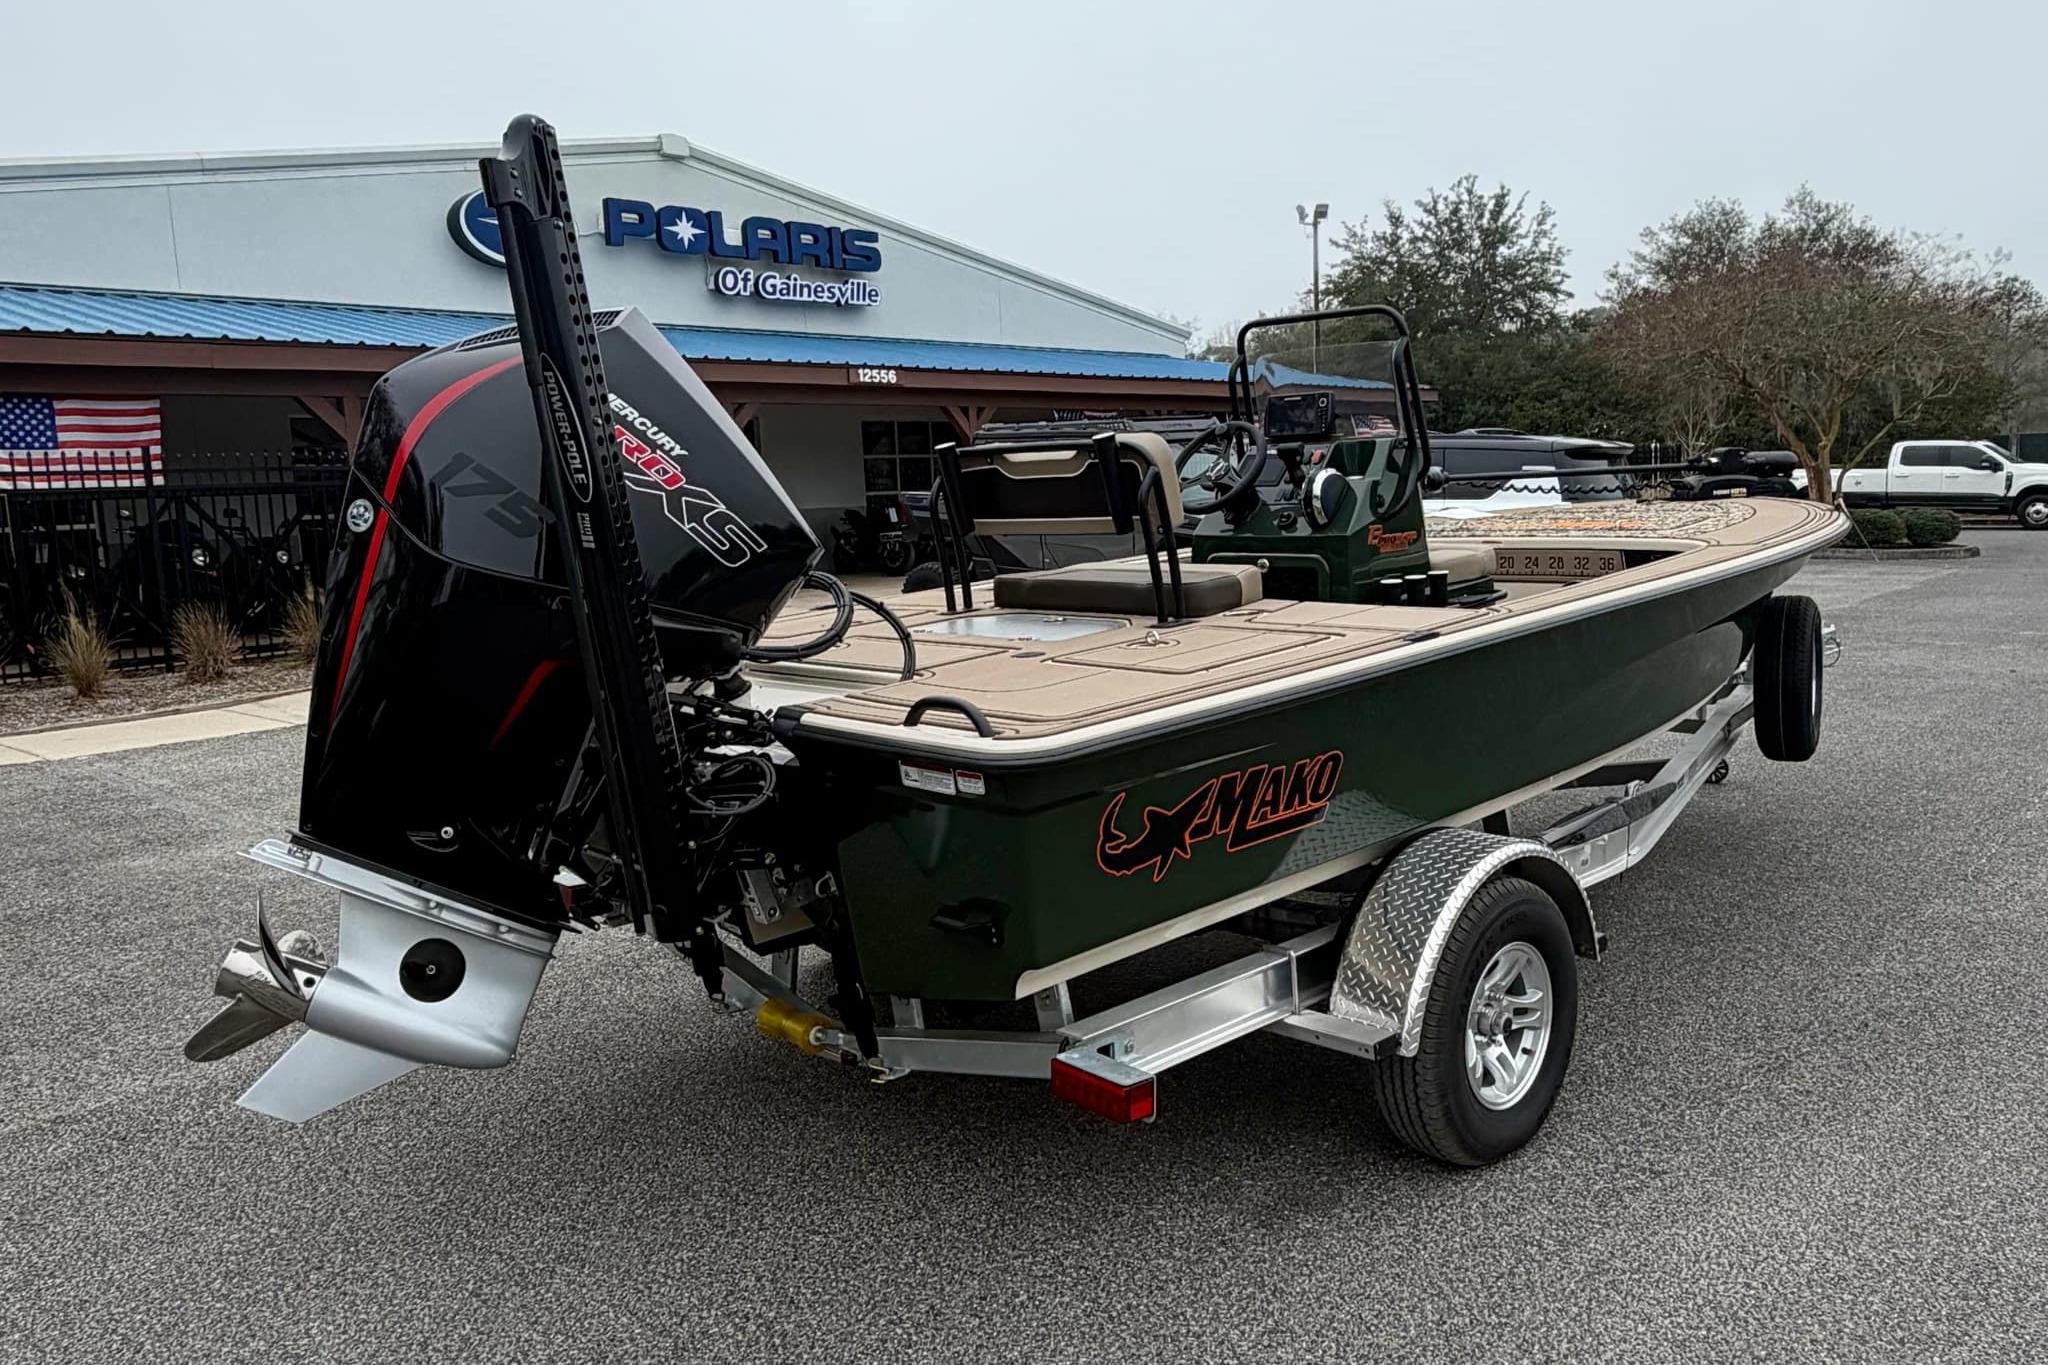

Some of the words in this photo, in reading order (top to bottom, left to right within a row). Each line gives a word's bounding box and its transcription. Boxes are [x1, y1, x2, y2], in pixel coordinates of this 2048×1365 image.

[603, 197, 881, 272] POLARIS
[718, 267, 753, 296] Of
[757, 272, 881, 306] Gainesville
[857, 368, 897, 384] 12556
[543, 371, 588, 485] POWER-POLE
[613, 424, 686, 490] RO
[429, 451, 556, 538] 175
[1500, 556, 1515, 570] 20
[1524, 556, 1539, 570] 24
[1549, 556, 1564, 570] 28
[1574, 556, 1589, 571] 32
[1599, 557, 1615, 571] 36
[1188, 750, 1344, 851] MAKO
